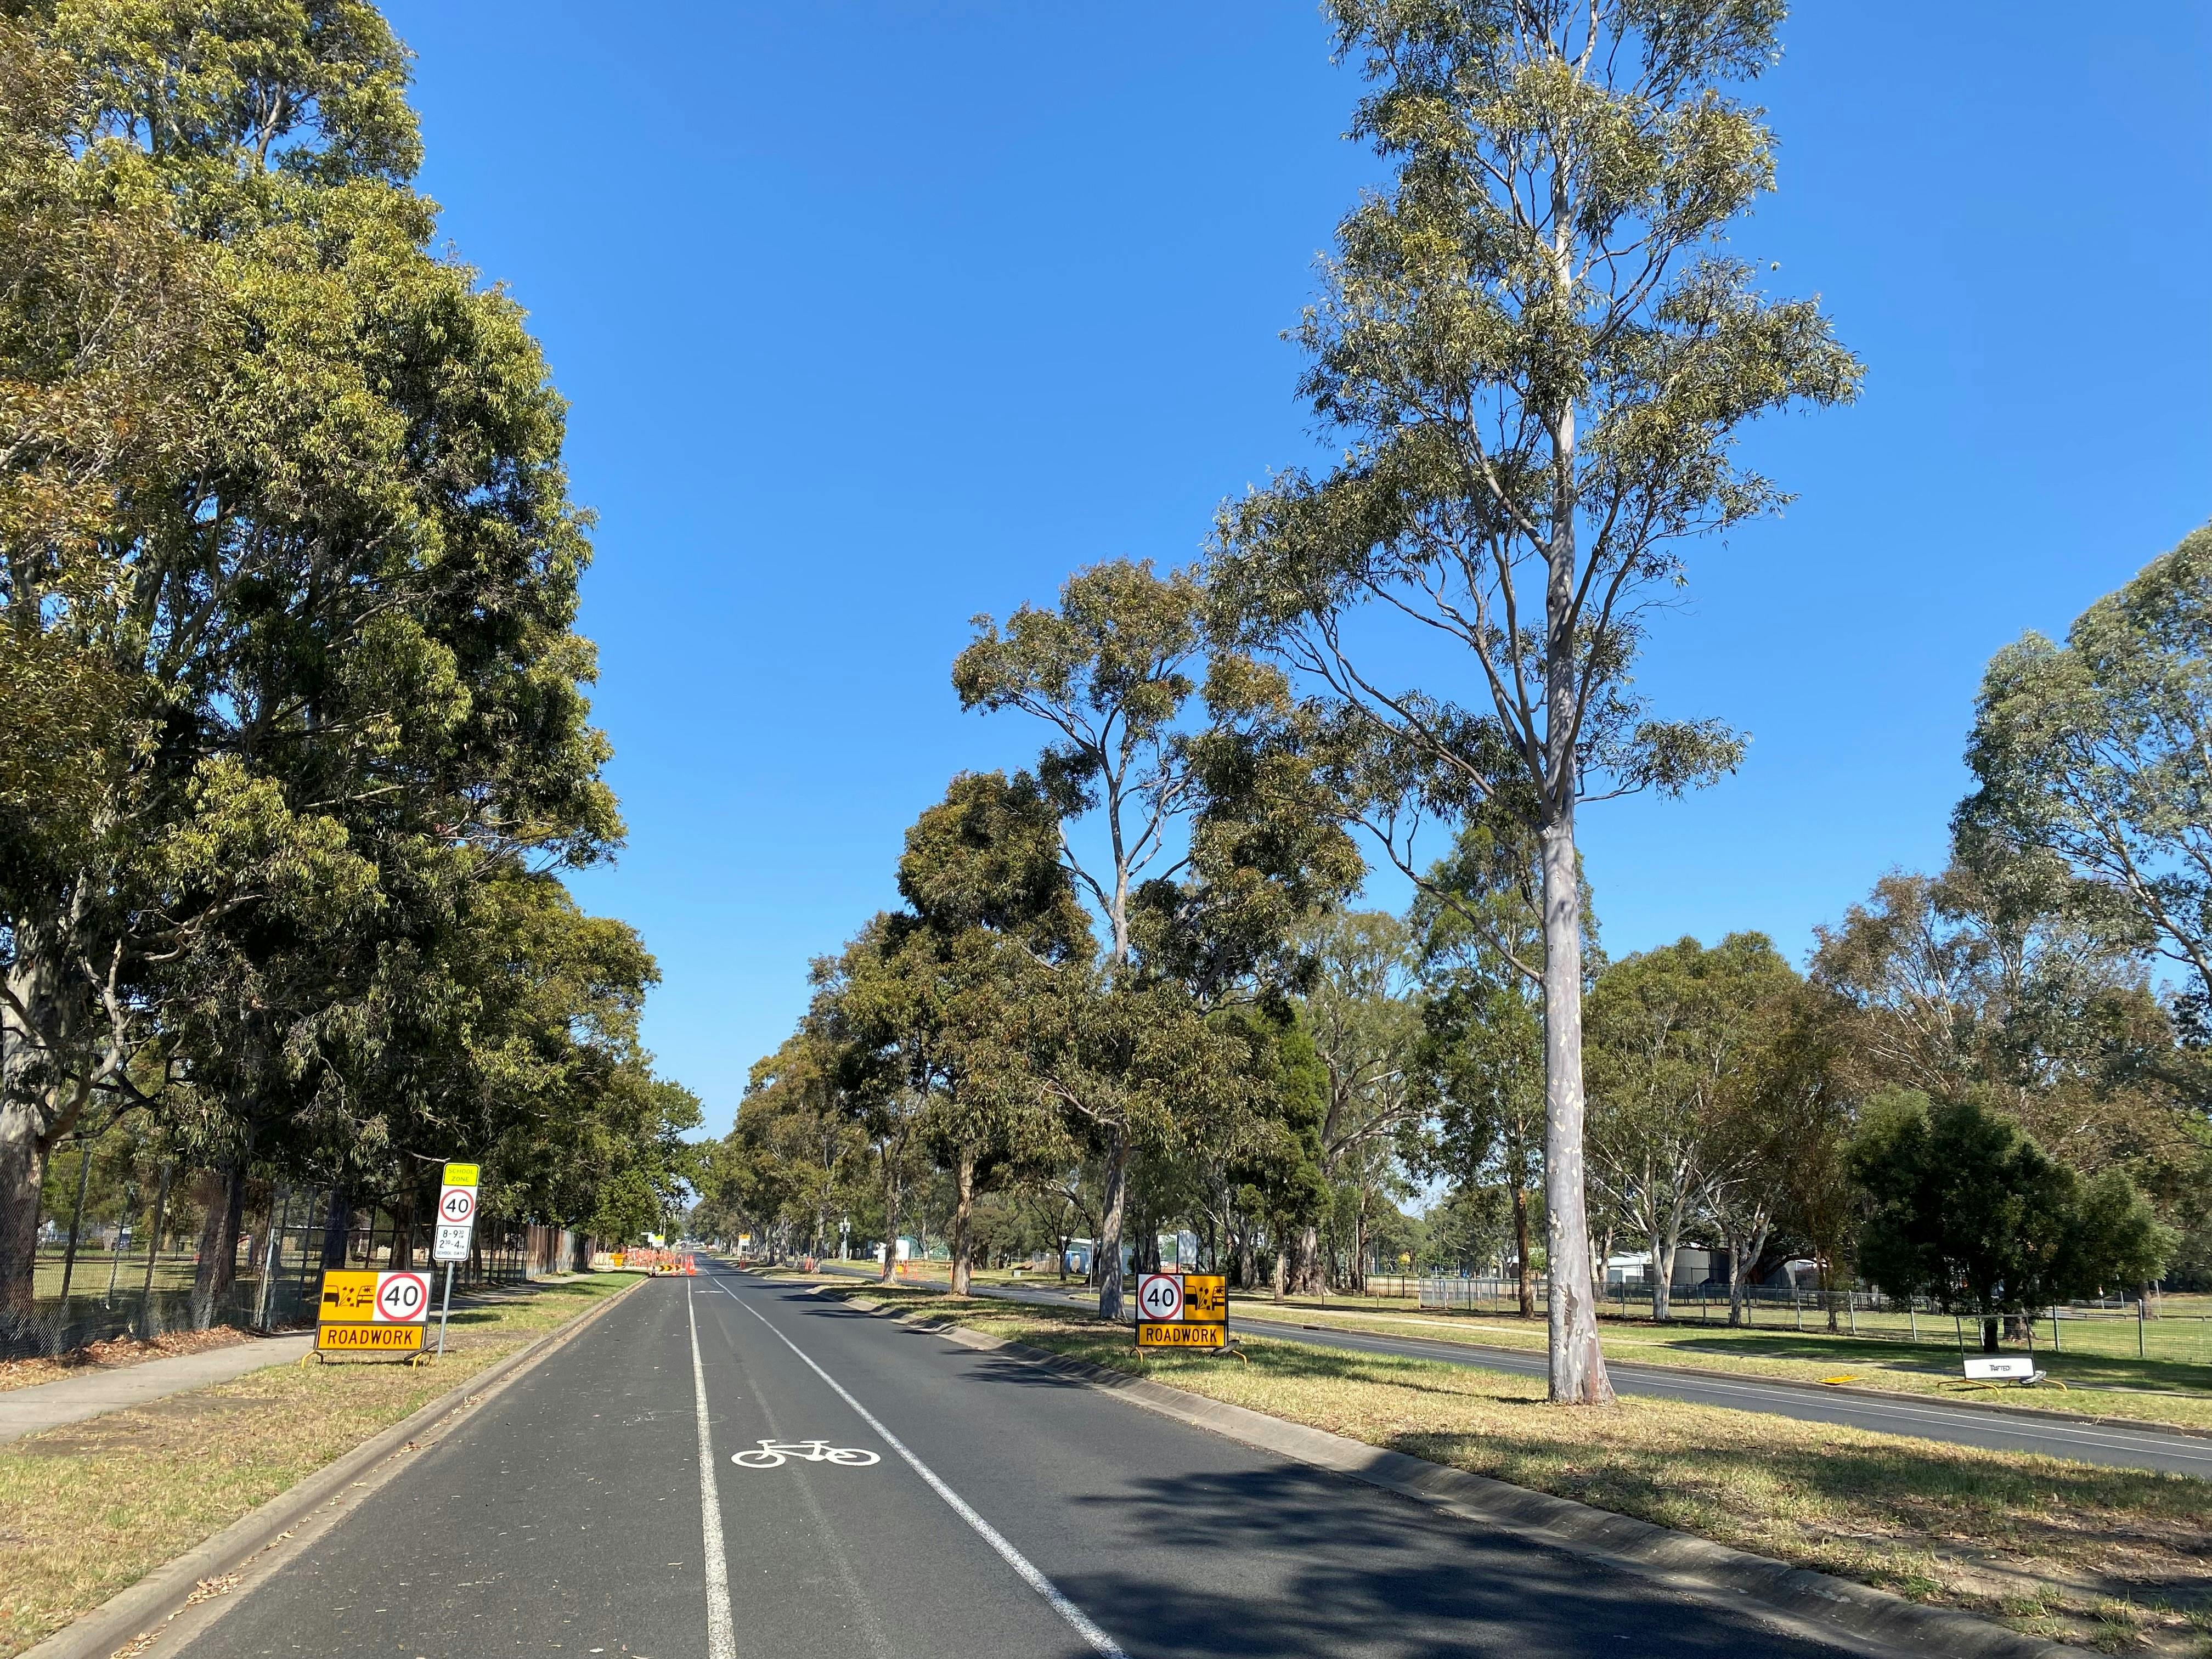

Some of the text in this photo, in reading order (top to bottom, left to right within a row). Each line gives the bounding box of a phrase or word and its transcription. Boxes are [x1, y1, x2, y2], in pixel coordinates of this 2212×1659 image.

[445, 1198, 469, 1214] 40
[385, 1285, 418, 1307] 40
[1147, 1288, 1174, 1307] 40
[328, 1329, 413, 1345] ROADWORK
[1146, 1328, 1217, 1342] ROADWORK
